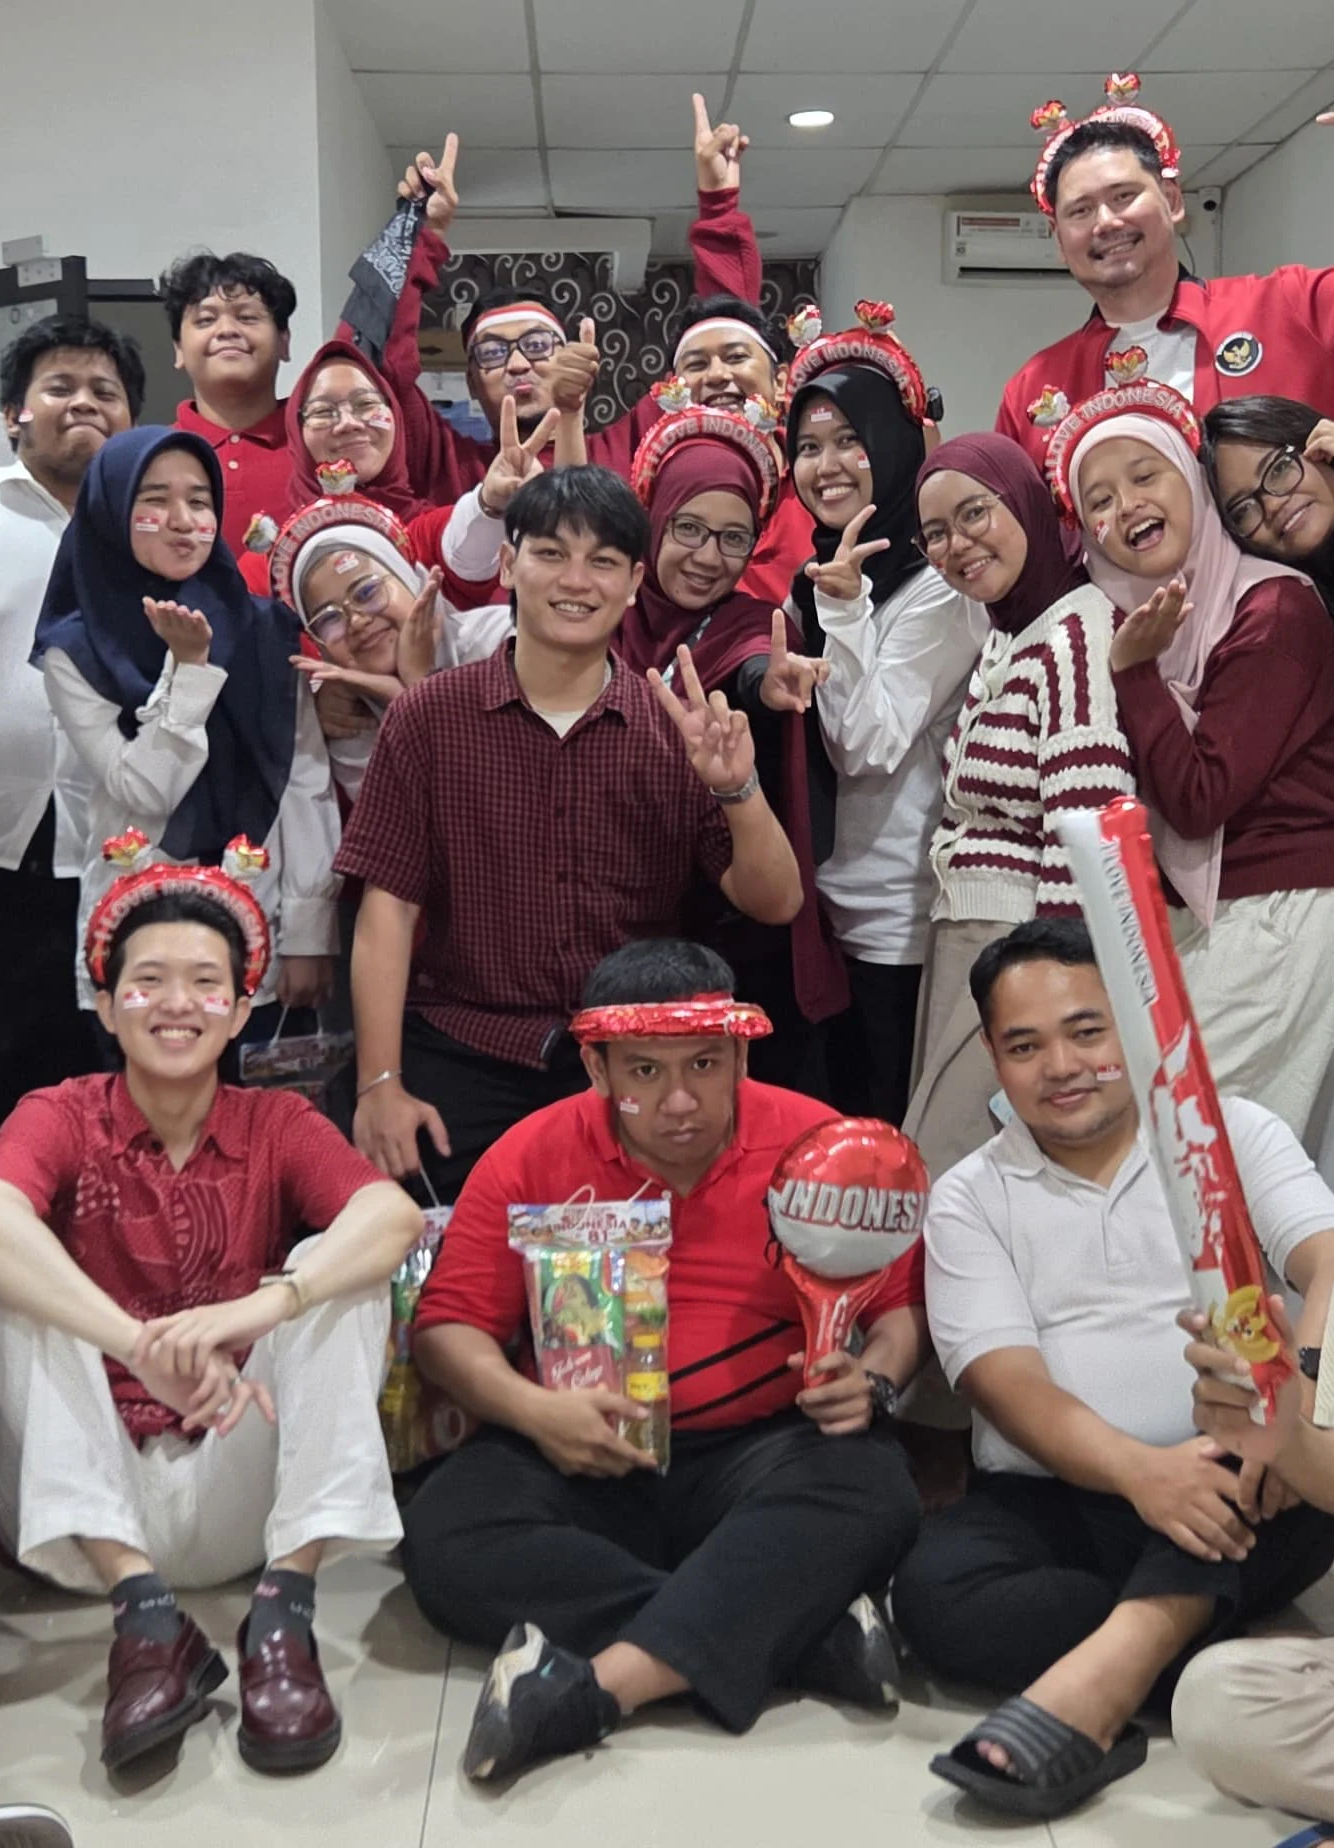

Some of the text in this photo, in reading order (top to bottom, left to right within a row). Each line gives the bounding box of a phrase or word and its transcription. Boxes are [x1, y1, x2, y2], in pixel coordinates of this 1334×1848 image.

[823, 341, 911, 391] INDONESIA
[651, 416, 699, 454] LOVE
[1045, 413, 1083, 467] LOVE
[1081, 386, 1186, 419] INDONESIA
[1117, 902, 1158, 1008] INDONESIA
